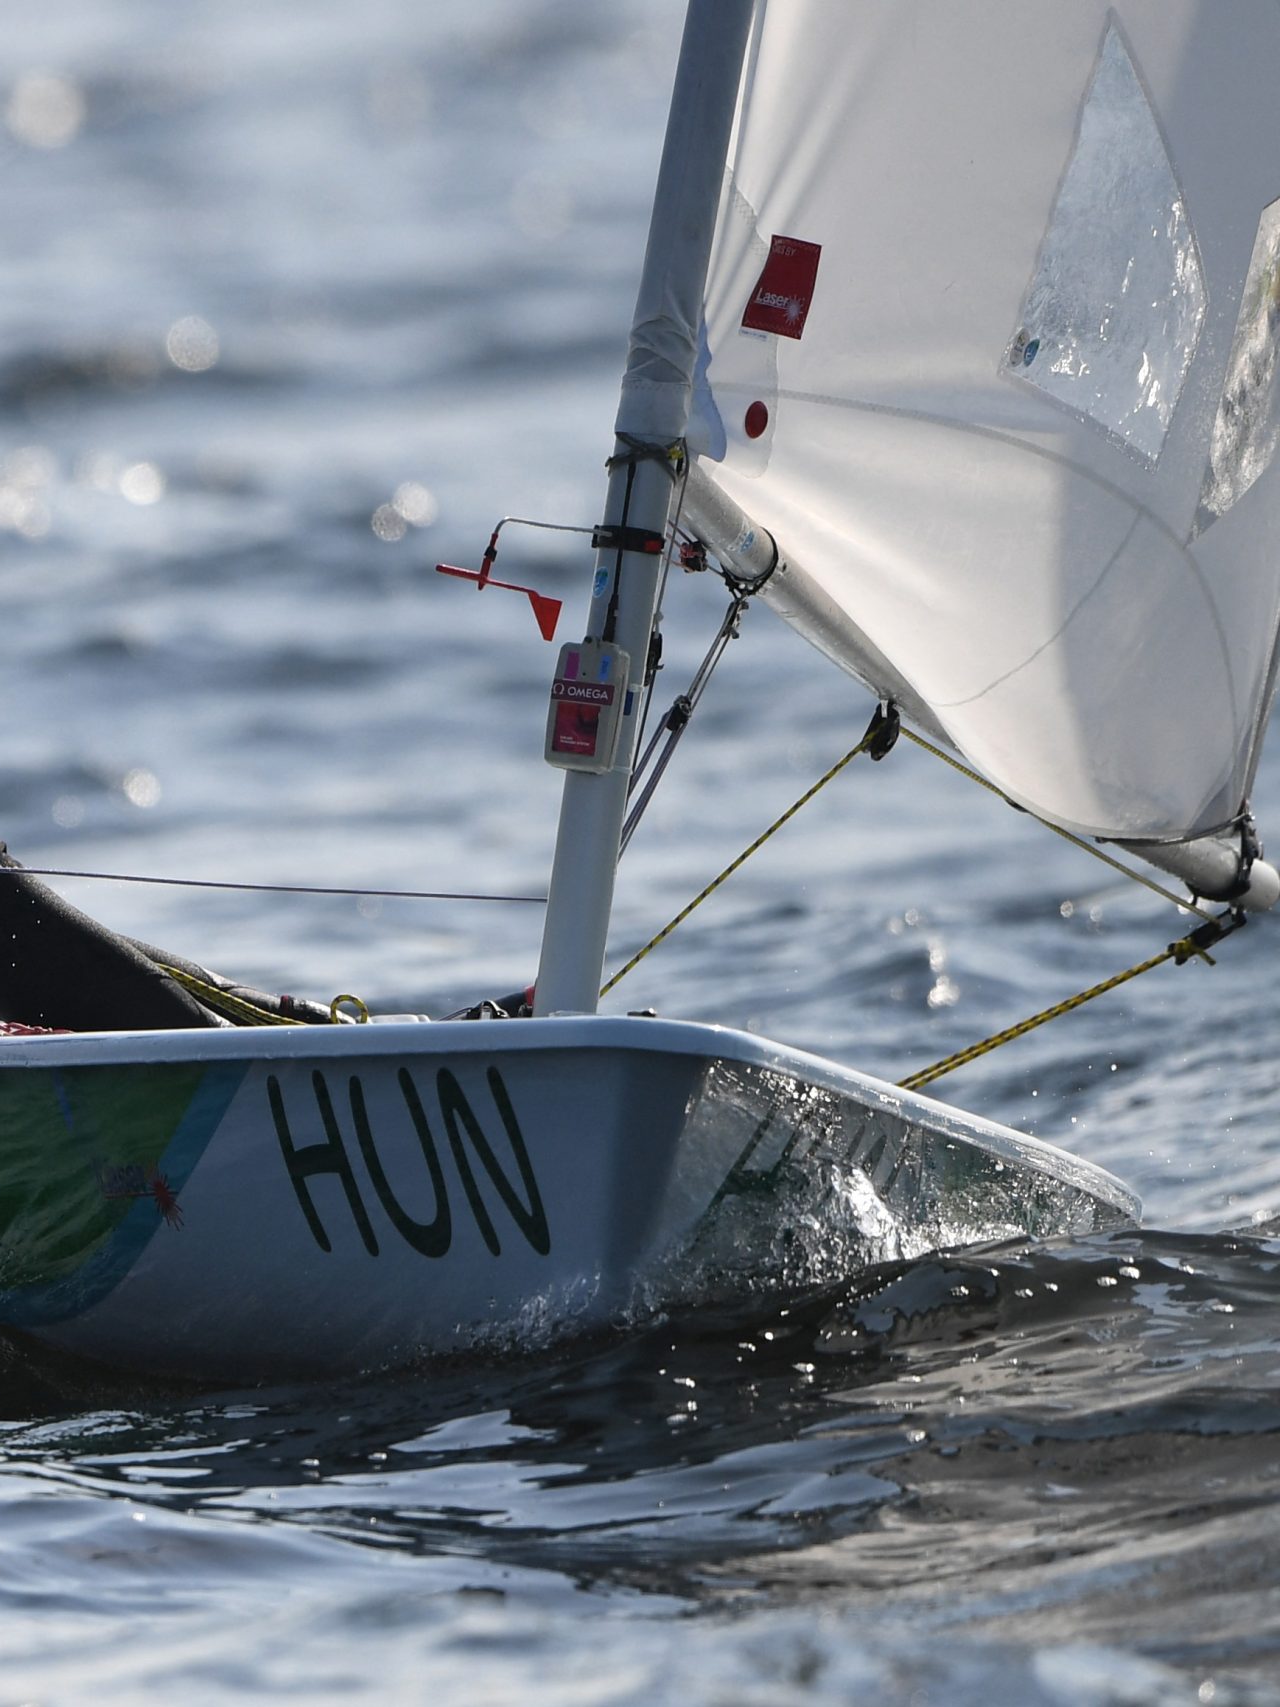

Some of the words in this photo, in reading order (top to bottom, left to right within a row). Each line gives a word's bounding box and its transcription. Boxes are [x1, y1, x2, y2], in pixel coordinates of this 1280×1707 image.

[755, 287, 789, 308] Laser
[567, 686, 608, 700] OMEGA
[267, 1066, 552, 1259] HUN
